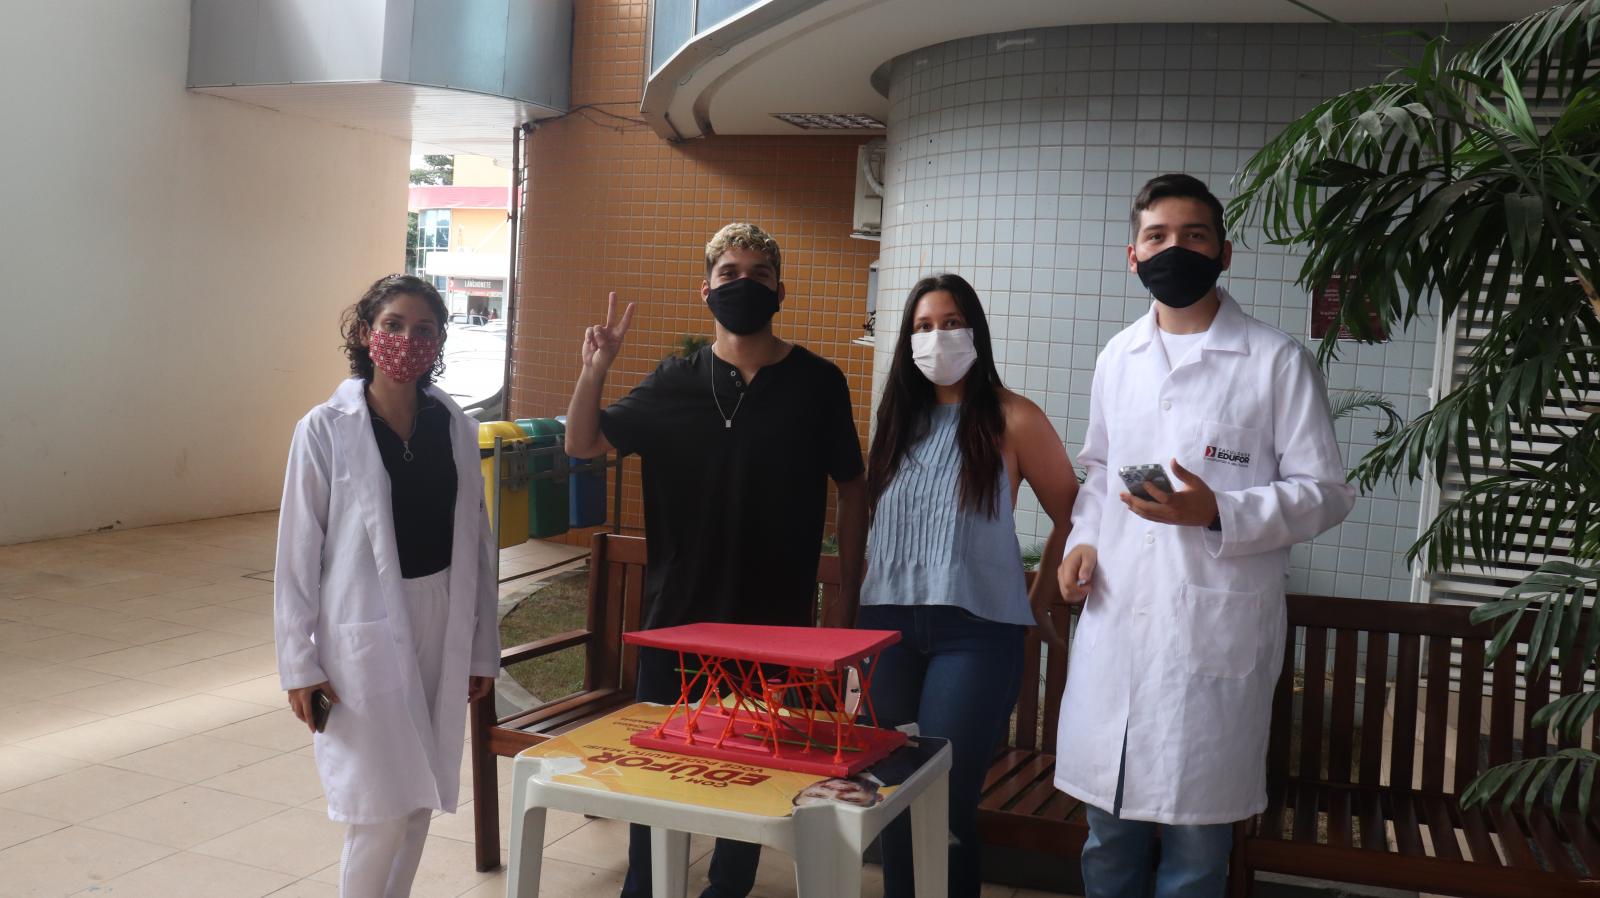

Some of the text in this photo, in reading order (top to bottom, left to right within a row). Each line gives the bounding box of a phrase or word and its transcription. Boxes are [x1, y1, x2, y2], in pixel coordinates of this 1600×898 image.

[1218, 452, 1250, 464] EDUFOR
[628, 750, 674, 760] MUITO
[676, 757, 718, 766] PODE
[587, 751, 772, 786] EDUFOR
[686, 778, 729, 788] COM
